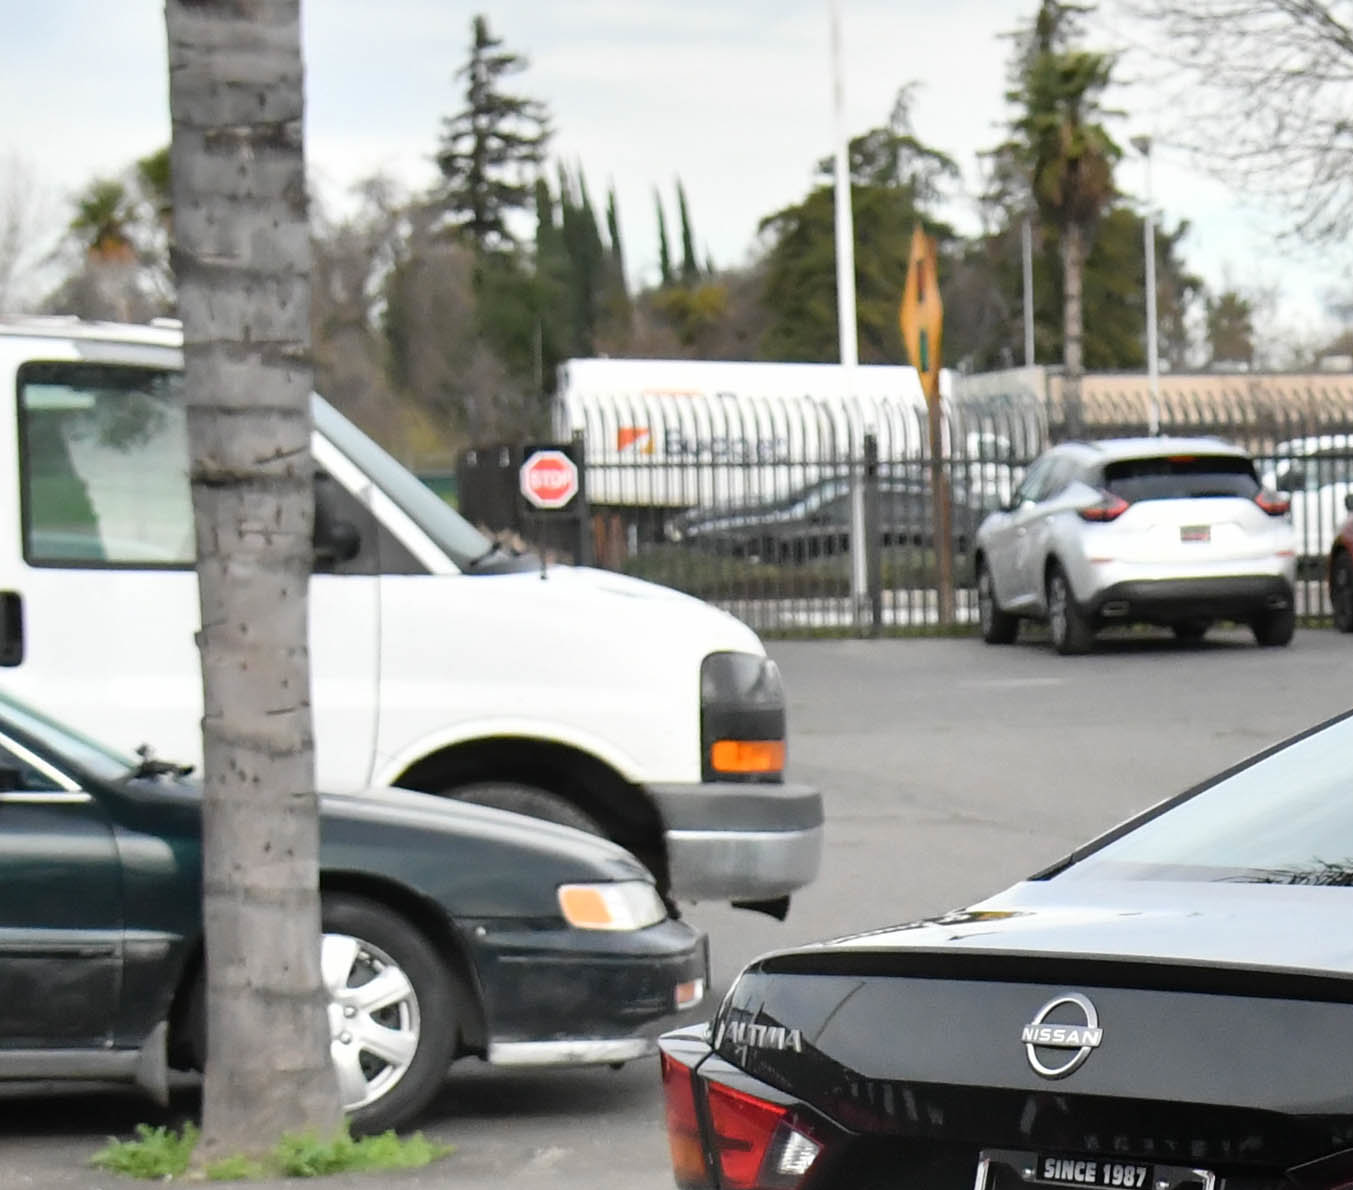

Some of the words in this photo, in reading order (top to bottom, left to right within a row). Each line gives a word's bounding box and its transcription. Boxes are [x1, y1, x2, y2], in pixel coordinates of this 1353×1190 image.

[529, 468, 571, 488] STOP
[1022, 1027, 1101, 1045] NISSAN
[1044, 1158, 1097, 1183] SINCE
[1103, 1163, 1147, 1188] 1987
